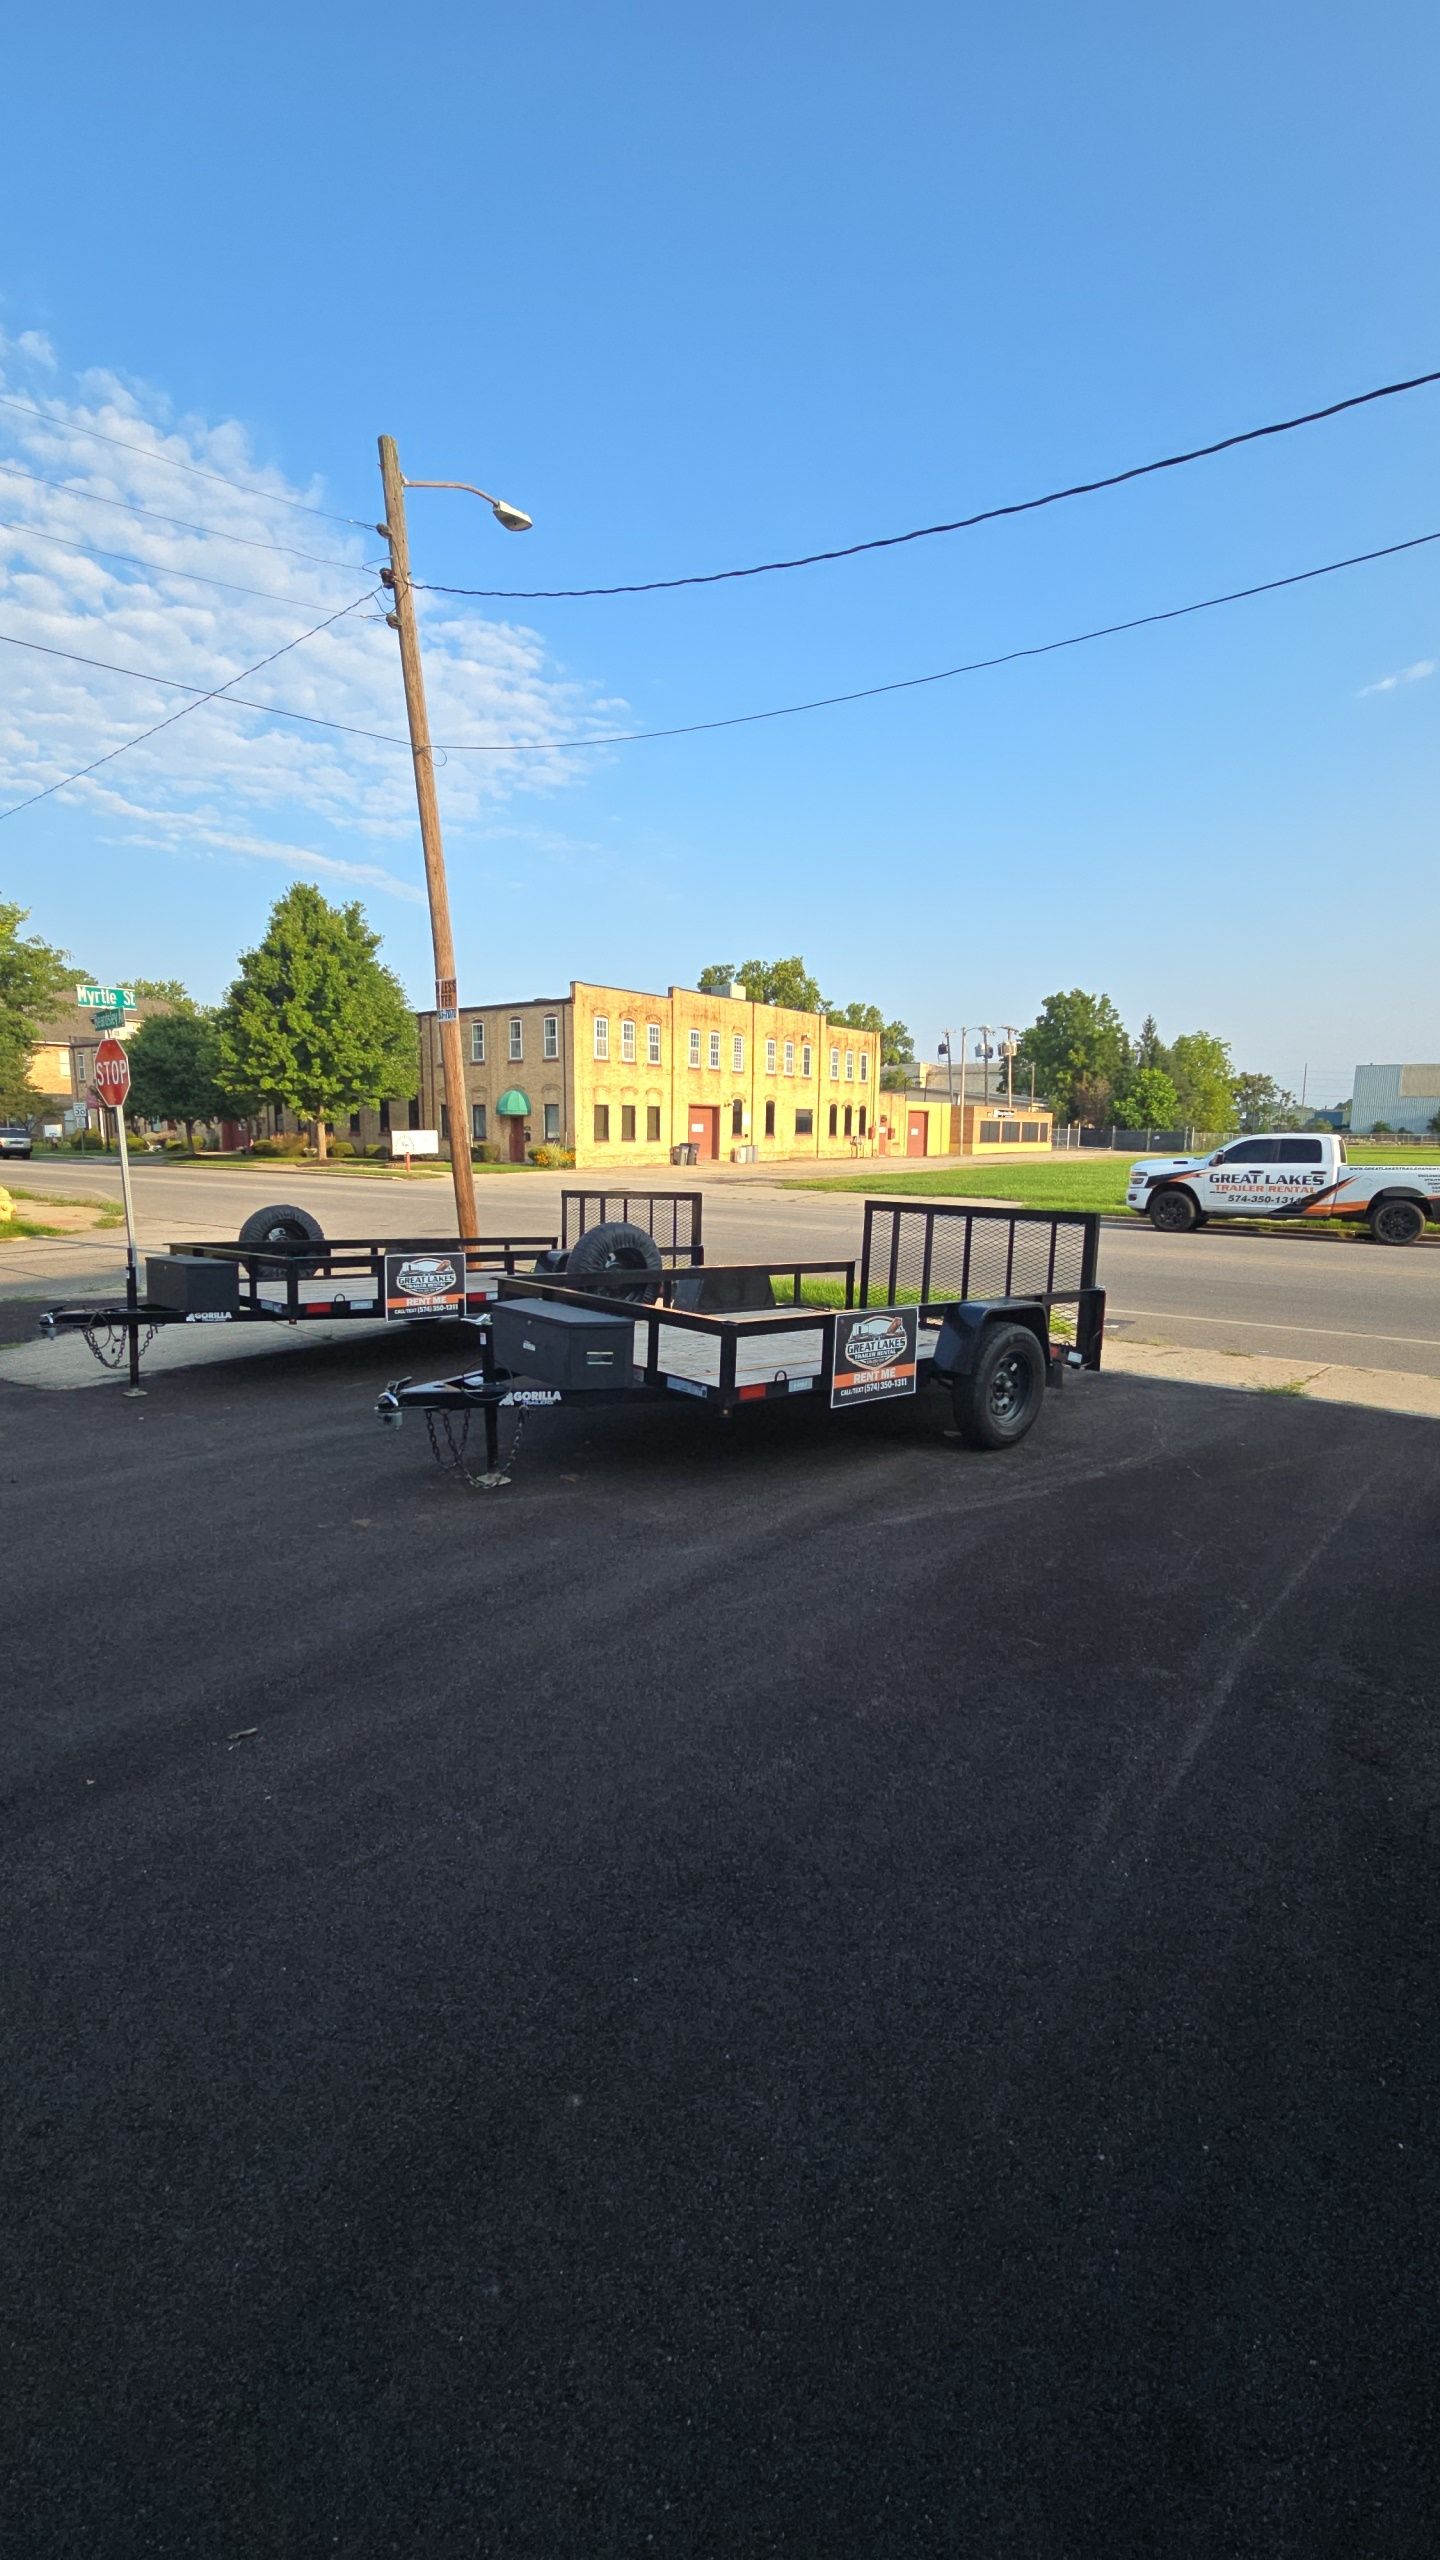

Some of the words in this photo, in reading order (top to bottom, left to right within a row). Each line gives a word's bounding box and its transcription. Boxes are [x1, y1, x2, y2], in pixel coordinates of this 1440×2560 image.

[77, 986, 117, 1006] Myrtle
[123, 990, 136, 1006] St
[96, 1060, 127, 1086] STOP
[1209, 1173, 1261, 1184] GREAT
[1265, 1174, 1325, 1186] LAKES
[1215, 1184, 1265, 1193] TRAILER
[1268, 1185, 1317, 1194] RENTAL
[399, 1276, 425, 1284] GREAT
[406, 1297, 430, 1307] RENT
[432, 1296, 447, 1305] ME
[194, 1311, 232, 1319] GORILLA
[417, 1306, 432, 1314] (574)
[433, 1304, 459, 1312] 350-1311
[848, 1343, 875, 1353] GREAT
[877, 1339, 905, 1349] LAKES
[853, 1371, 880, 1383] RENT
[881, 1368, 896, 1378] ME
[864, 1382, 880, 1393] (574)
[880, 1378, 907, 1389] 350-1311
[513, 1390, 562, 1401] GORILLA
